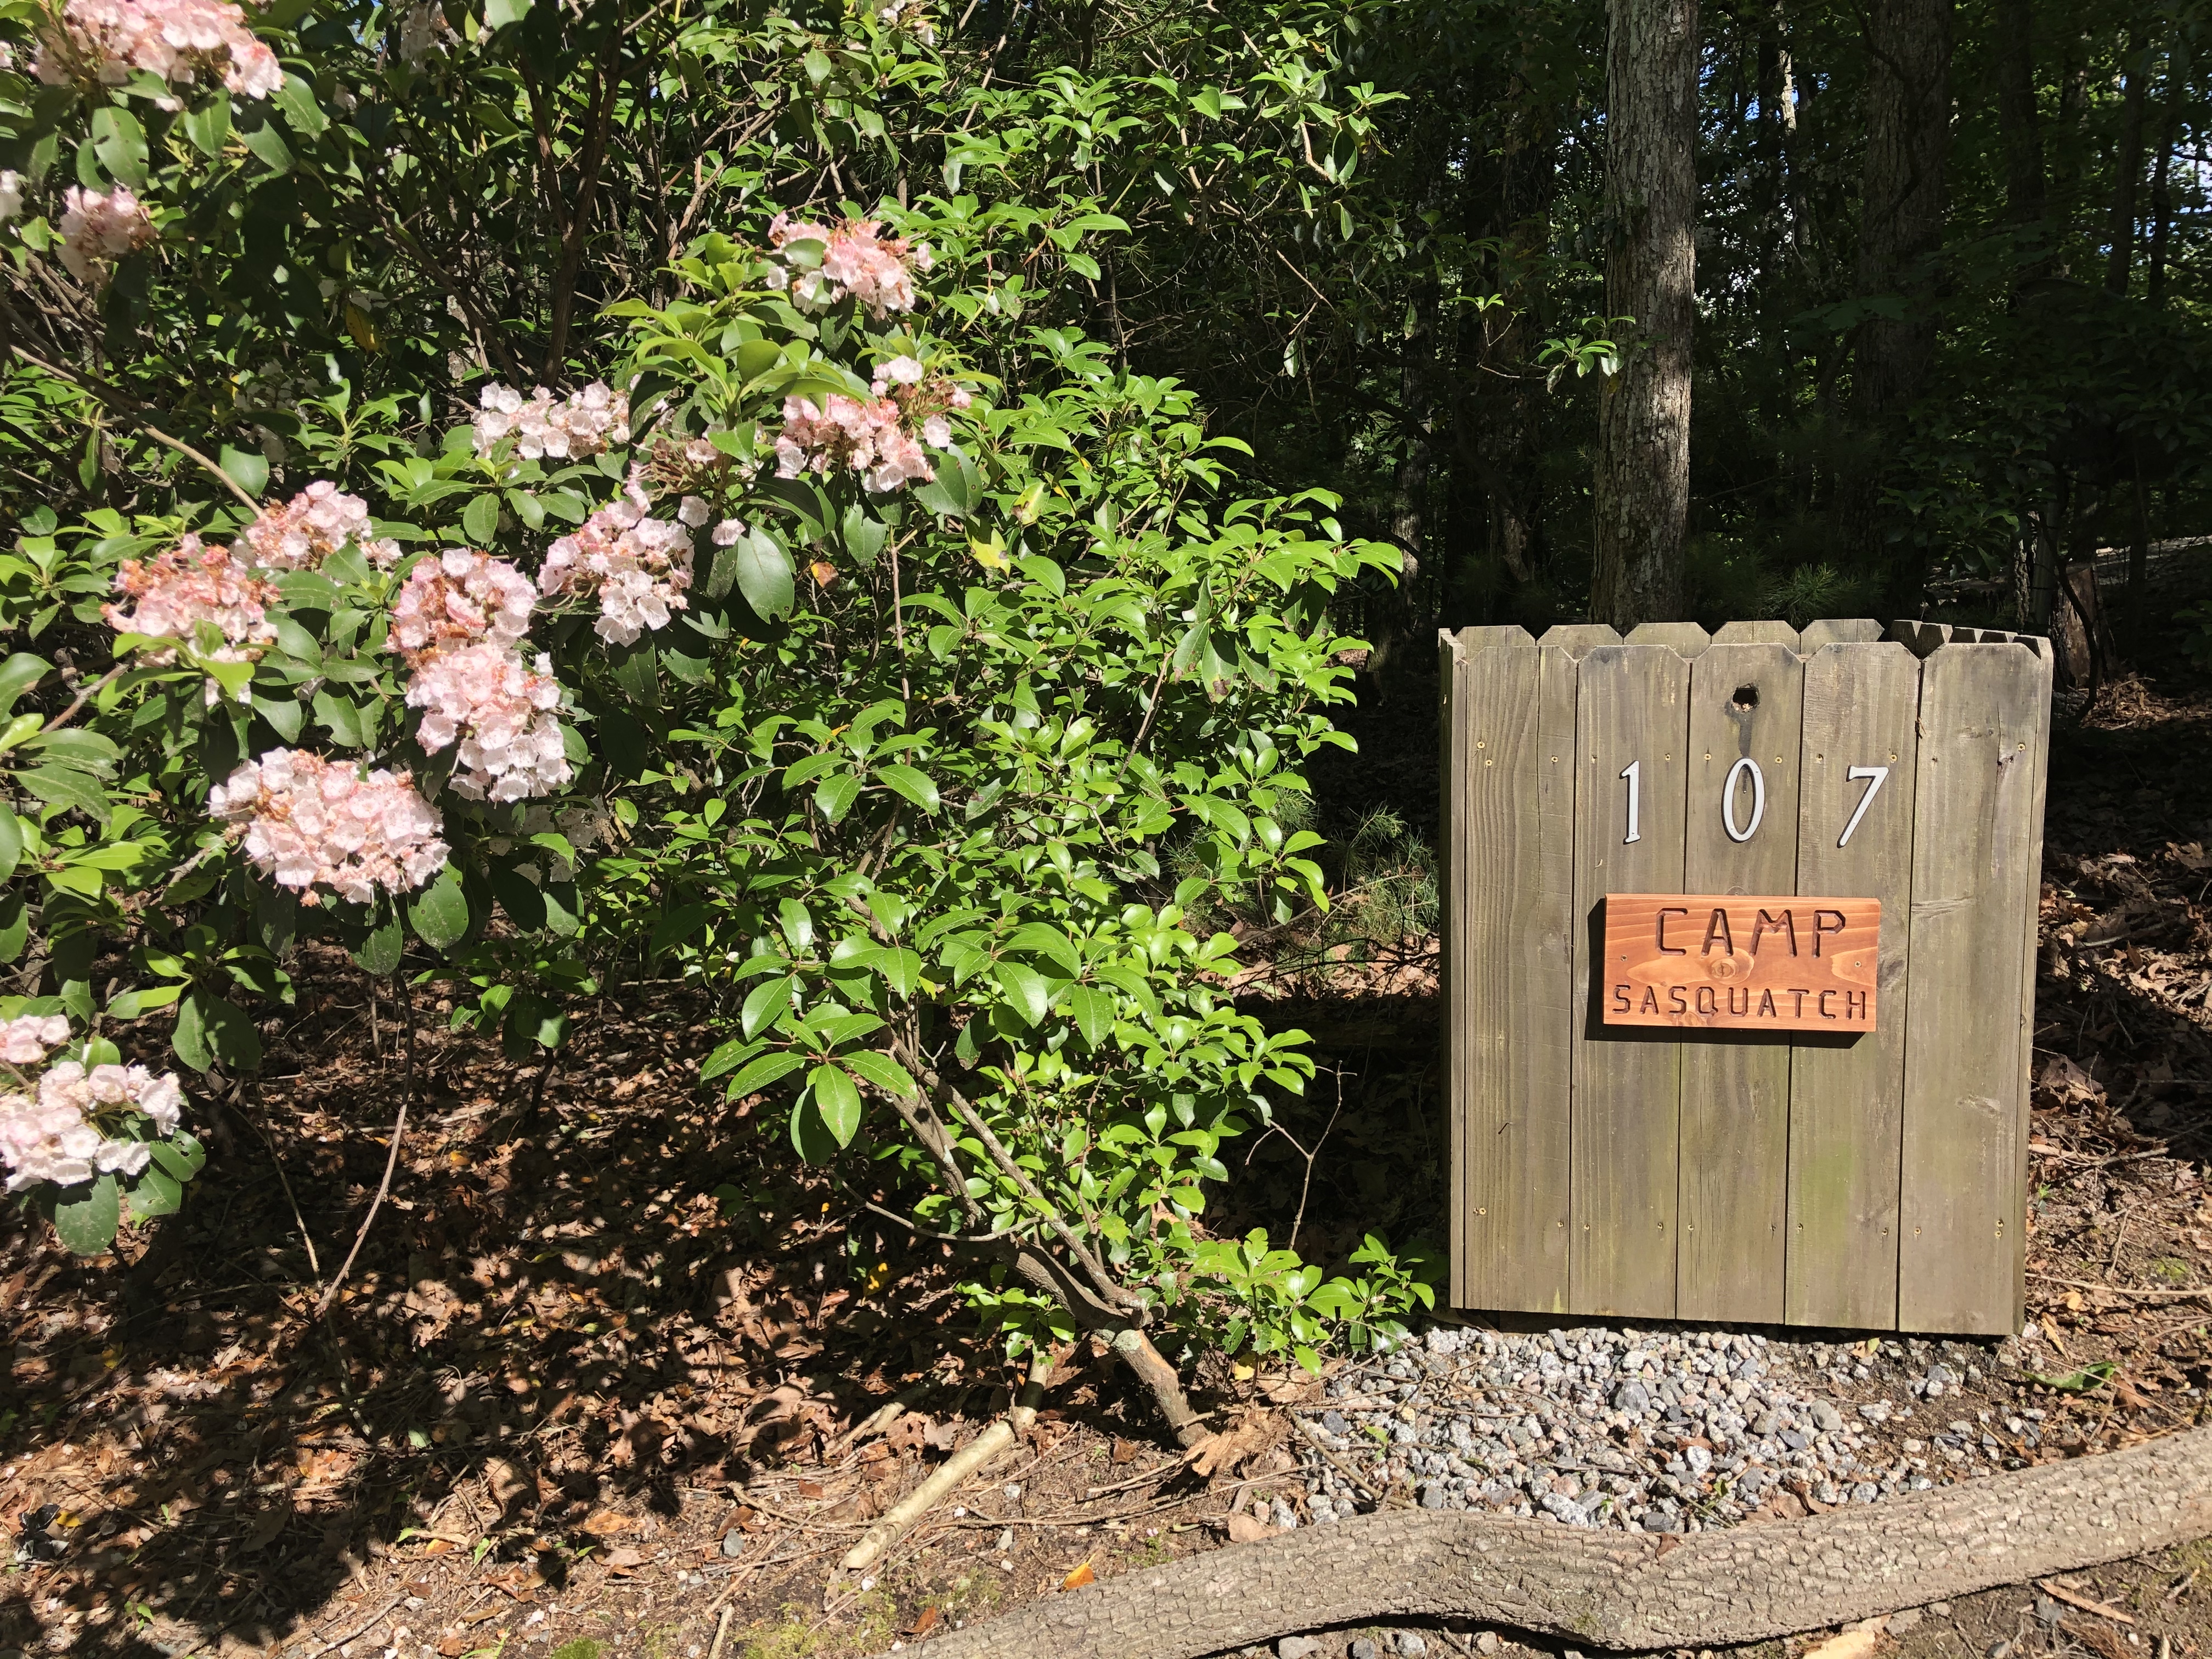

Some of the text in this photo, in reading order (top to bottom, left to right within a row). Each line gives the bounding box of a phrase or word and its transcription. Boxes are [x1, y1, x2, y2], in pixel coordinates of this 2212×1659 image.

[1620, 757, 1889, 848] 107
[1656, 908, 1846, 958] CAMP
[1612, 985, 1866, 1020] SASQUATCH
